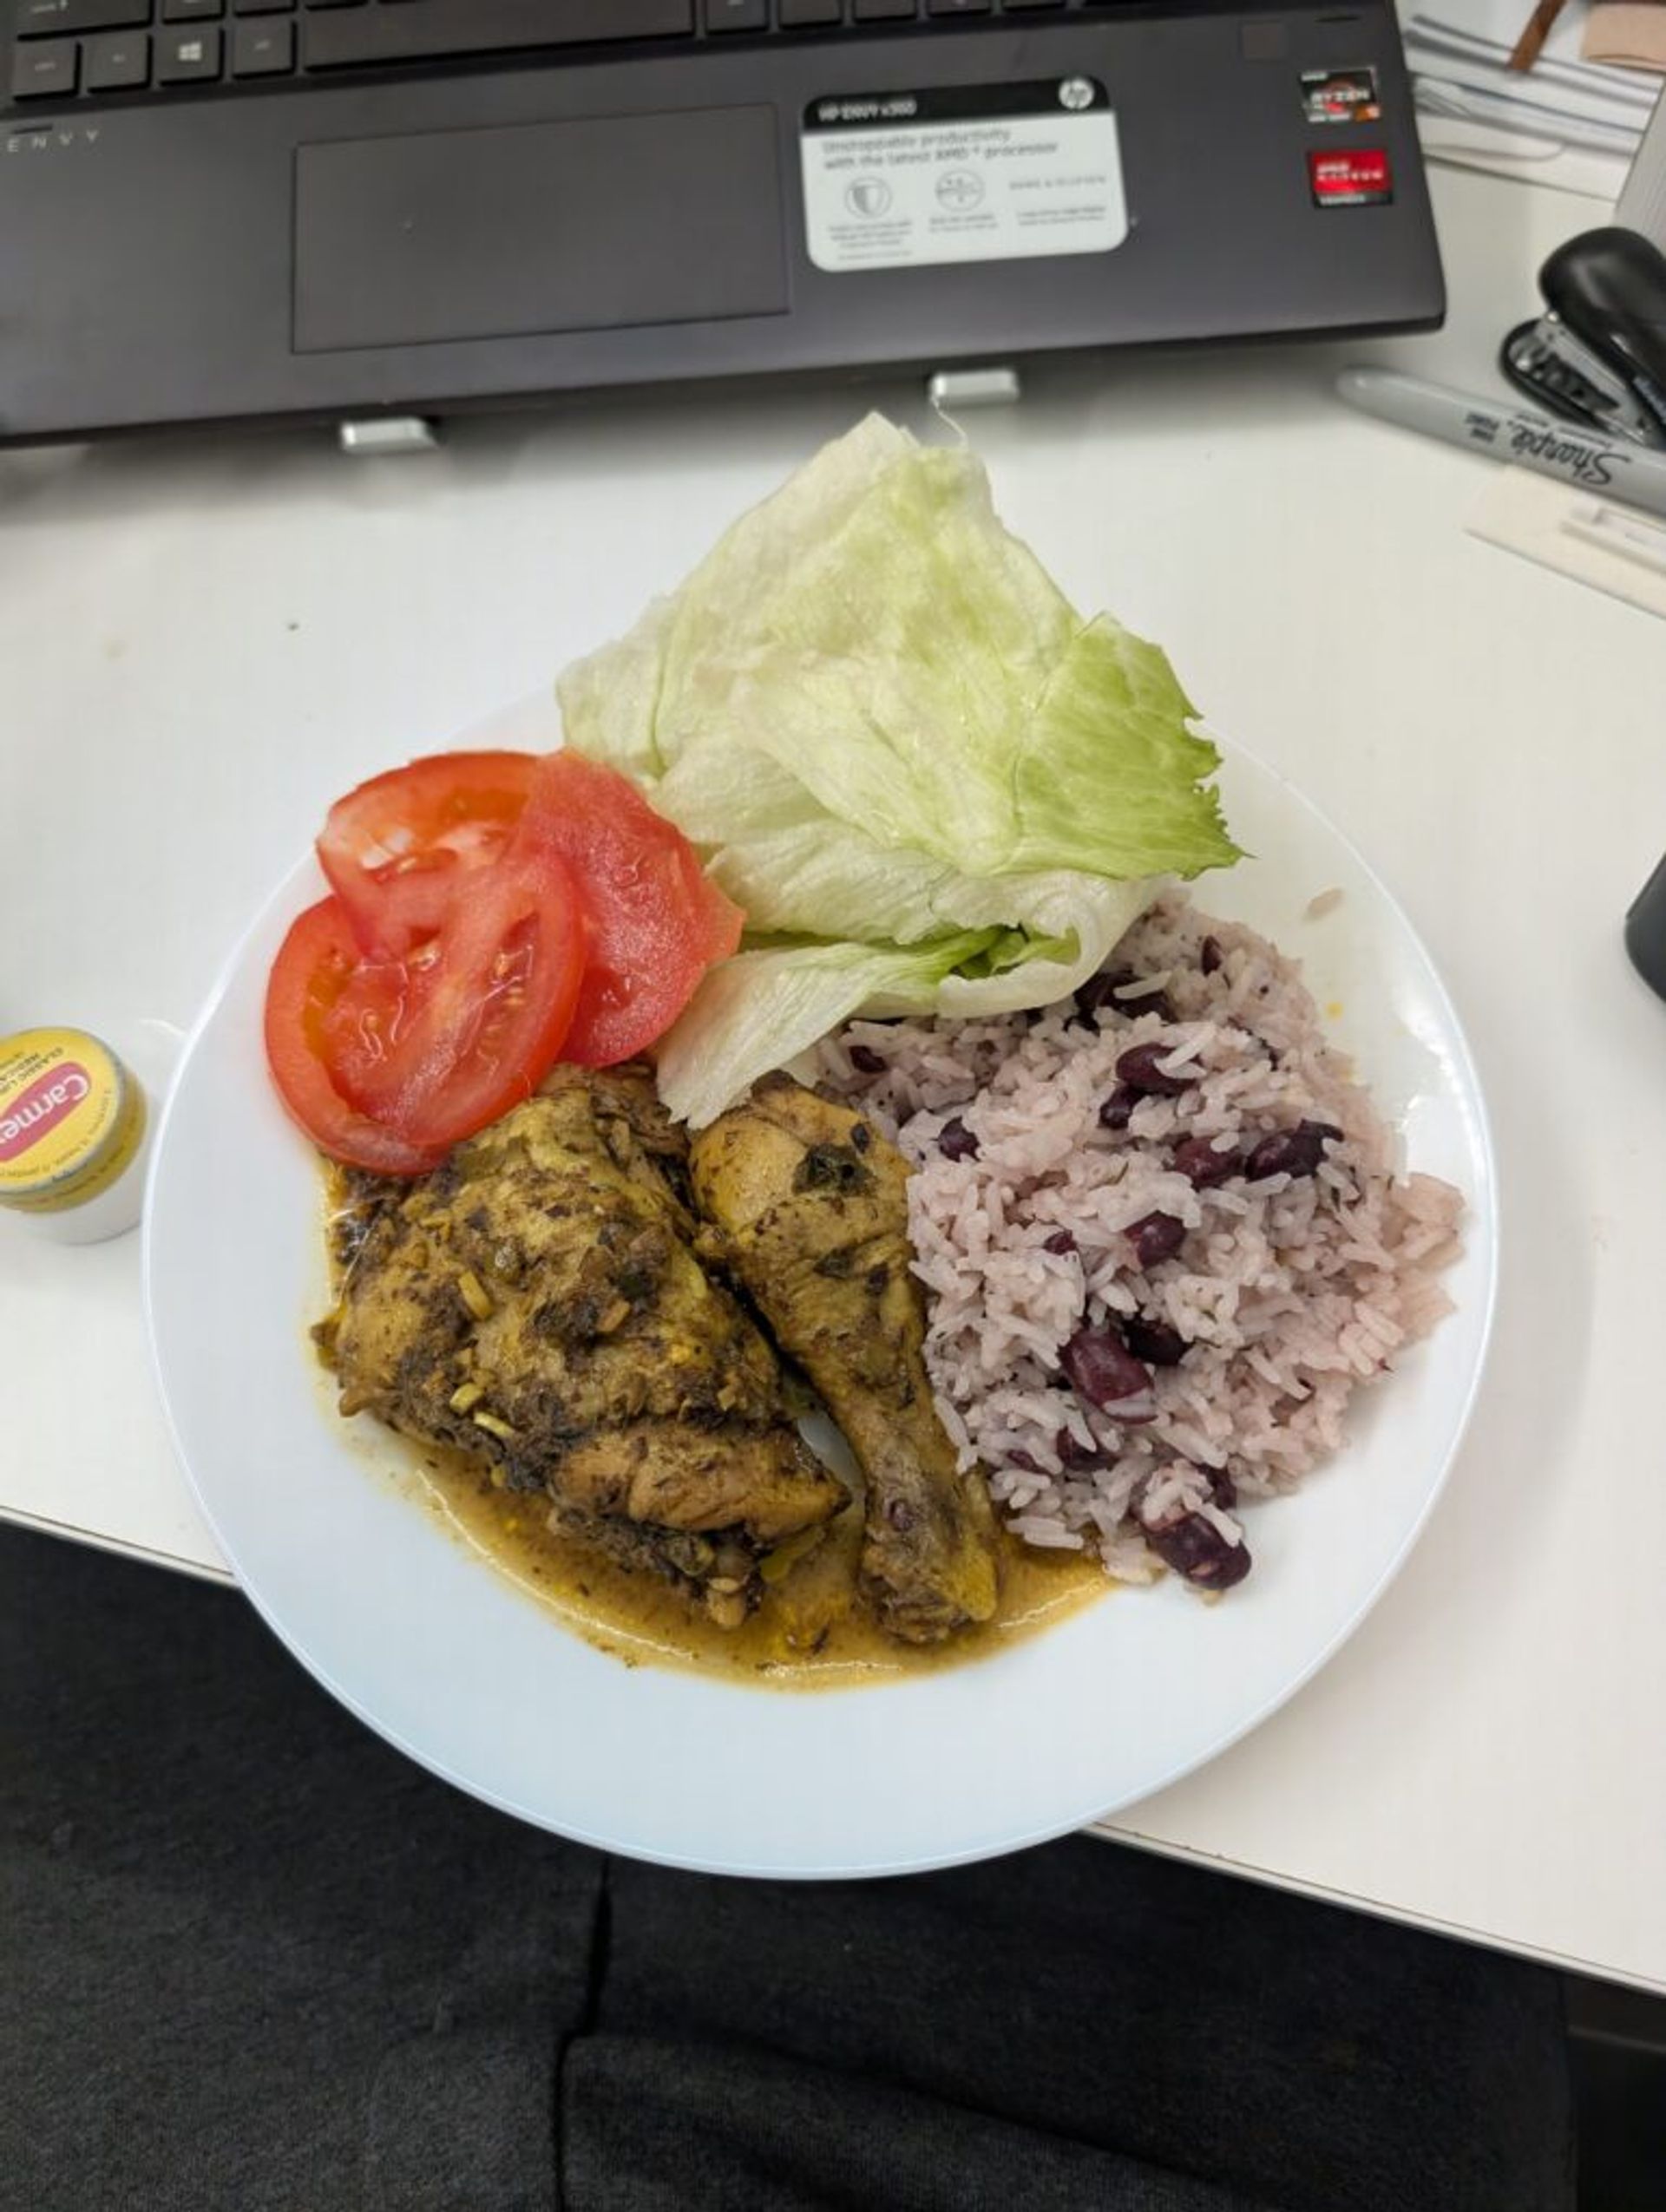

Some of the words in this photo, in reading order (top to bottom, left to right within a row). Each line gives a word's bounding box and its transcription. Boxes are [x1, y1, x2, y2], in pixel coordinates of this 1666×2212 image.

[5, 128, 101, 154] ENVY
[921, 128, 1011, 149] productivity
[825, 155, 855, 170] with
[859, 154, 883, 167] the
[1511, 424, 1632, 486] Sharpie
[0, 1074, 89, 1144] Carme
